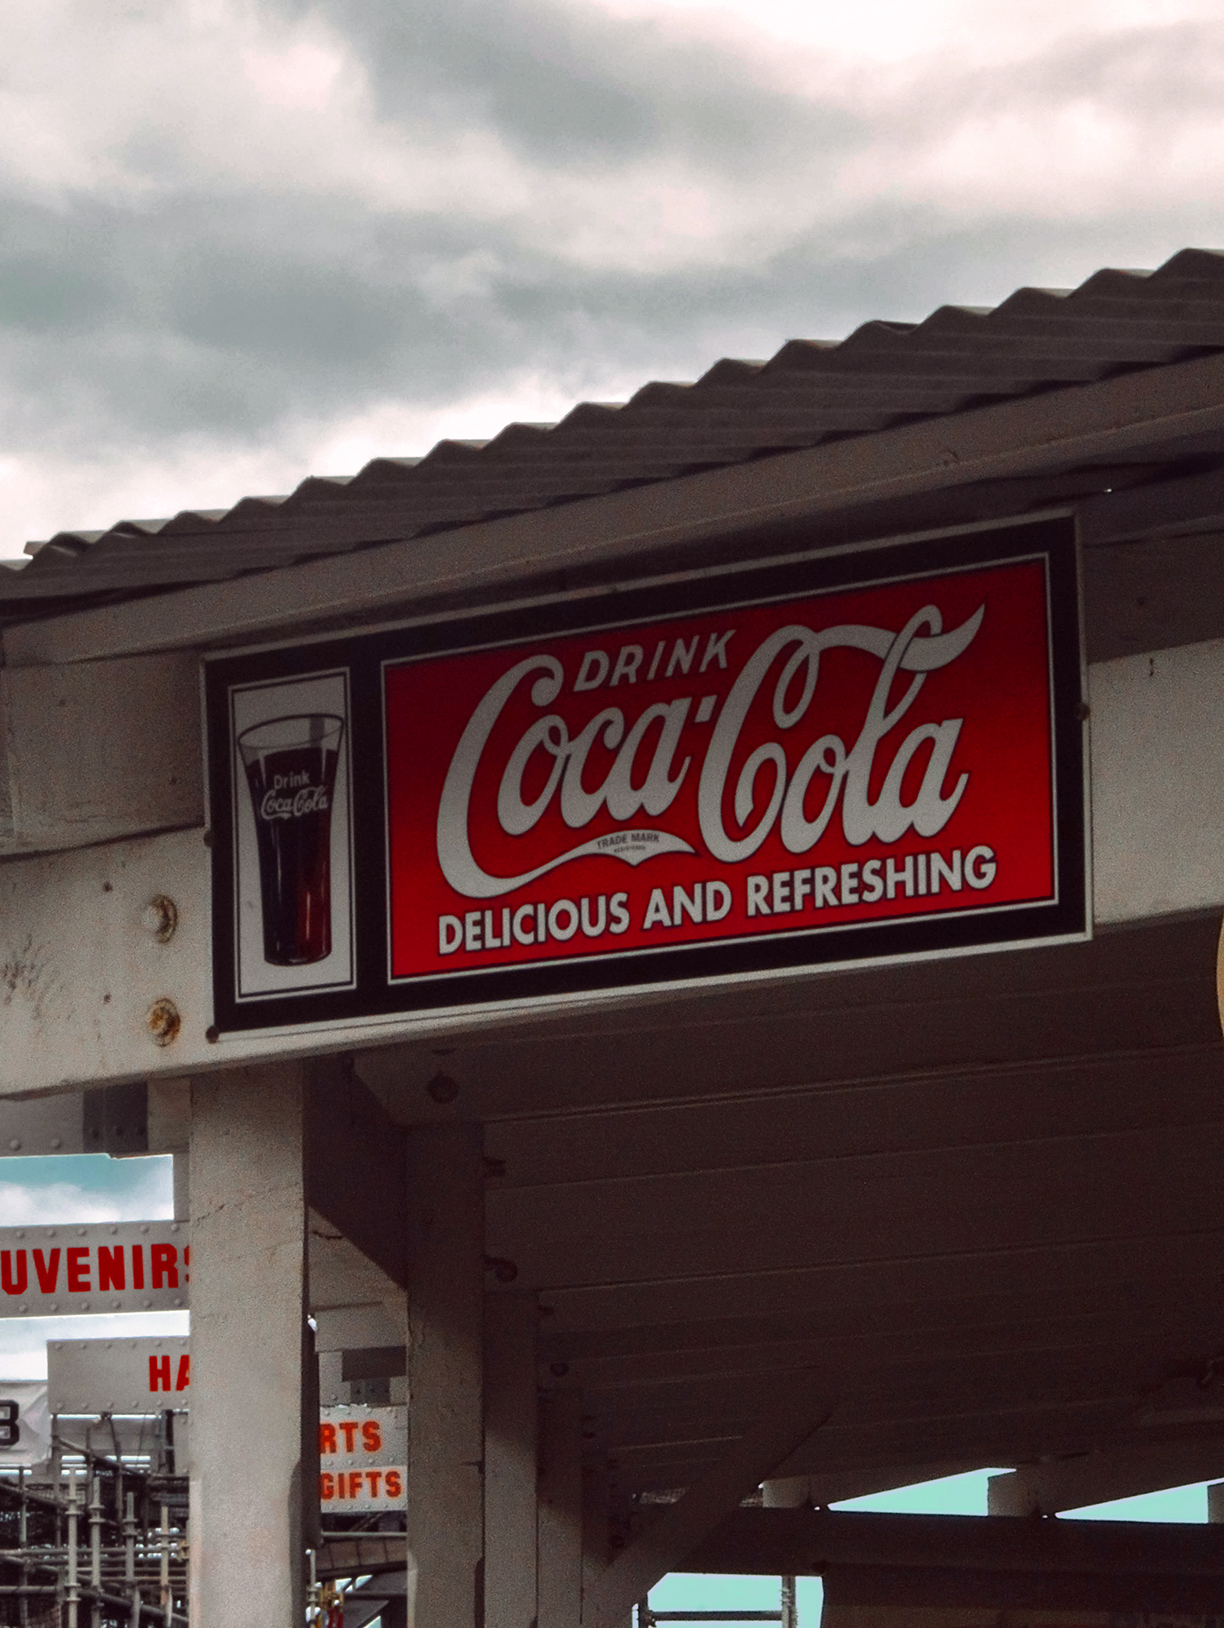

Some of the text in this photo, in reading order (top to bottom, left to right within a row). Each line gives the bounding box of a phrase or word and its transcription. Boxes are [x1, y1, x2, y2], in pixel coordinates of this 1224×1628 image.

[573, 629, 737, 692] DRINK
[437, 603, 985, 898] Coca-Cola
[274, 769, 310, 790] Drink
[596, 834, 628, 849] TRADE
[631, 832, 660, 843] MARK
[438, 845, 997, 955] DELICIOUS AND REFRESHING
[320, 1470, 403, 1500] GIFTS
